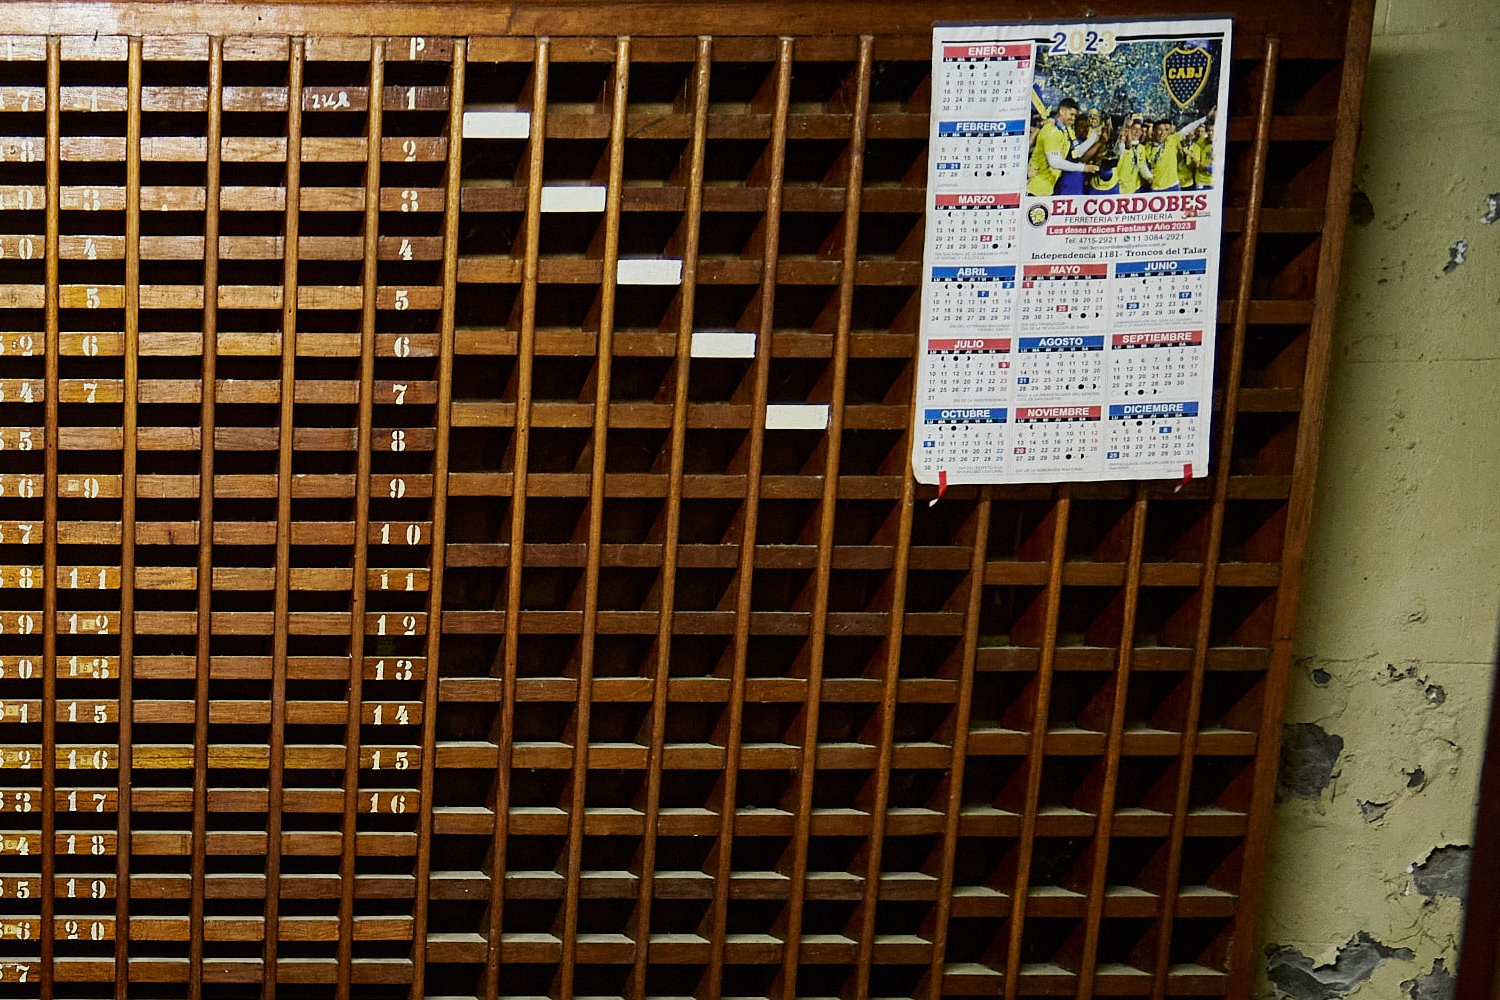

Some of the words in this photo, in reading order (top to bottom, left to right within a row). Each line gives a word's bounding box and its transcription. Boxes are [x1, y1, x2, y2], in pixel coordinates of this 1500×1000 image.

[410, 37, 425, 60] P
[1050, 30, 1117, 55] 2023
[968, 47, 1006, 55] ENERO
[1168, 67, 1203, 79] CABJ
[407, 87, 415, 109] 1
[956, 123, 1006, 131] FEBRERO
[403, 140, 416, 161] 2
[402, 188, 418, 212] 3
[1052, 200, 1077, 215] EL
[1084, 194, 1207, 215] CORDOBES
[1122, 213, 1173, 221] PINTURERIA
[1088, 226, 1115, 234] Felices
[1117, 225, 1146, 233] Fiestas
[1155, 223, 1170, 231] Año
[1172, 222, 1191, 230] 2023
[399, 239, 412, 260] 4
[1125, 249, 1162, 257] Troncos
[958, 268, 988, 276] ABRIL
[1145, 262, 1177, 270] JUNIO
[395, 290, 408, 310] 5
[1039, 338, 1083, 346] AGOSTO
[1123, 332, 1192, 343] SEPTIEMBRE
[394, 337, 410, 357] 6
[954, 340, 984, 348] JULIO
[393, 384, 407, 404] 7
[1028, 408, 1089, 416] NOVIEMBRE
[1124, 404, 1183, 413] DICIEMBRE
[391, 431, 405, 451] 8
[390, 479, 405, 498] 9
